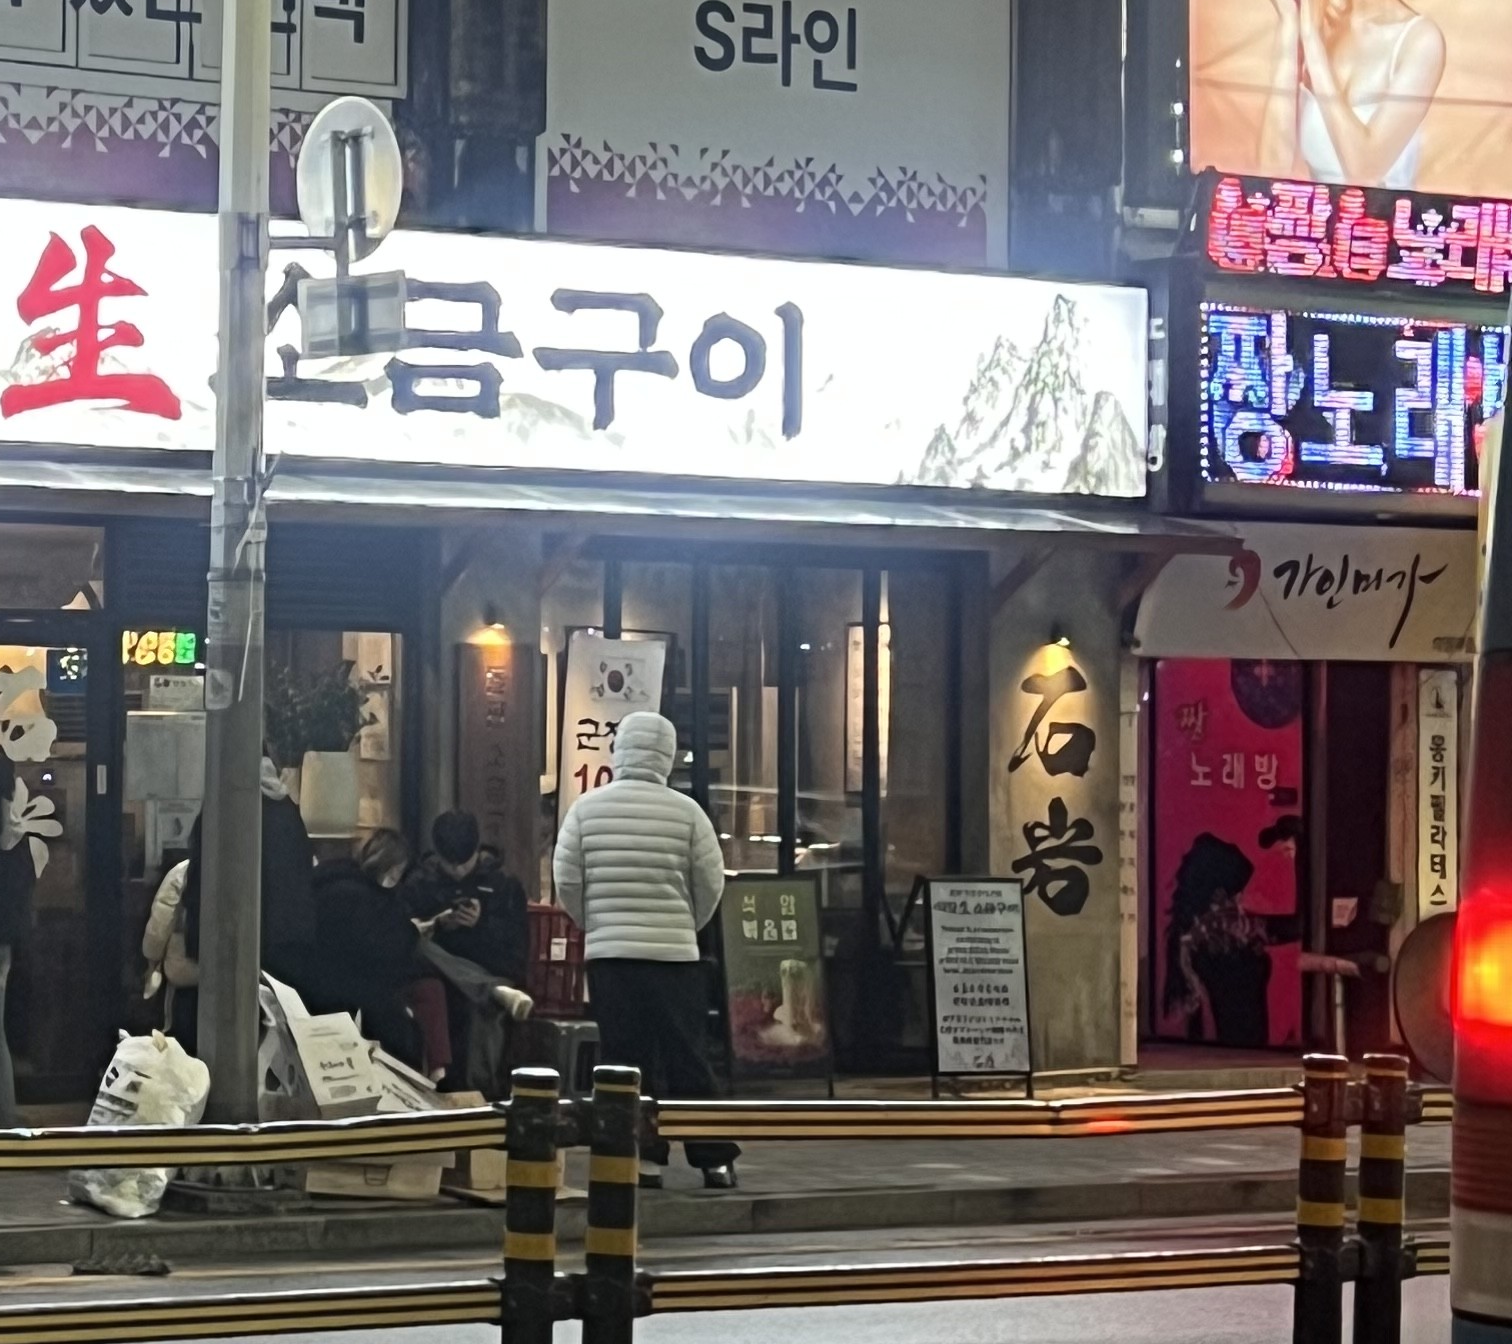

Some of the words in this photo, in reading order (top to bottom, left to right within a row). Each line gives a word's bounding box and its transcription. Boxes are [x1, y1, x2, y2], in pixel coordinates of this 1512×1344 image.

[1273, 551, 1450, 650] 가인미가
[1007, 664, 1104, 917] 石岩
[1189, 751, 1279, 791] 노래방
[1428, 734, 1448, 906] 몽키필라테스
